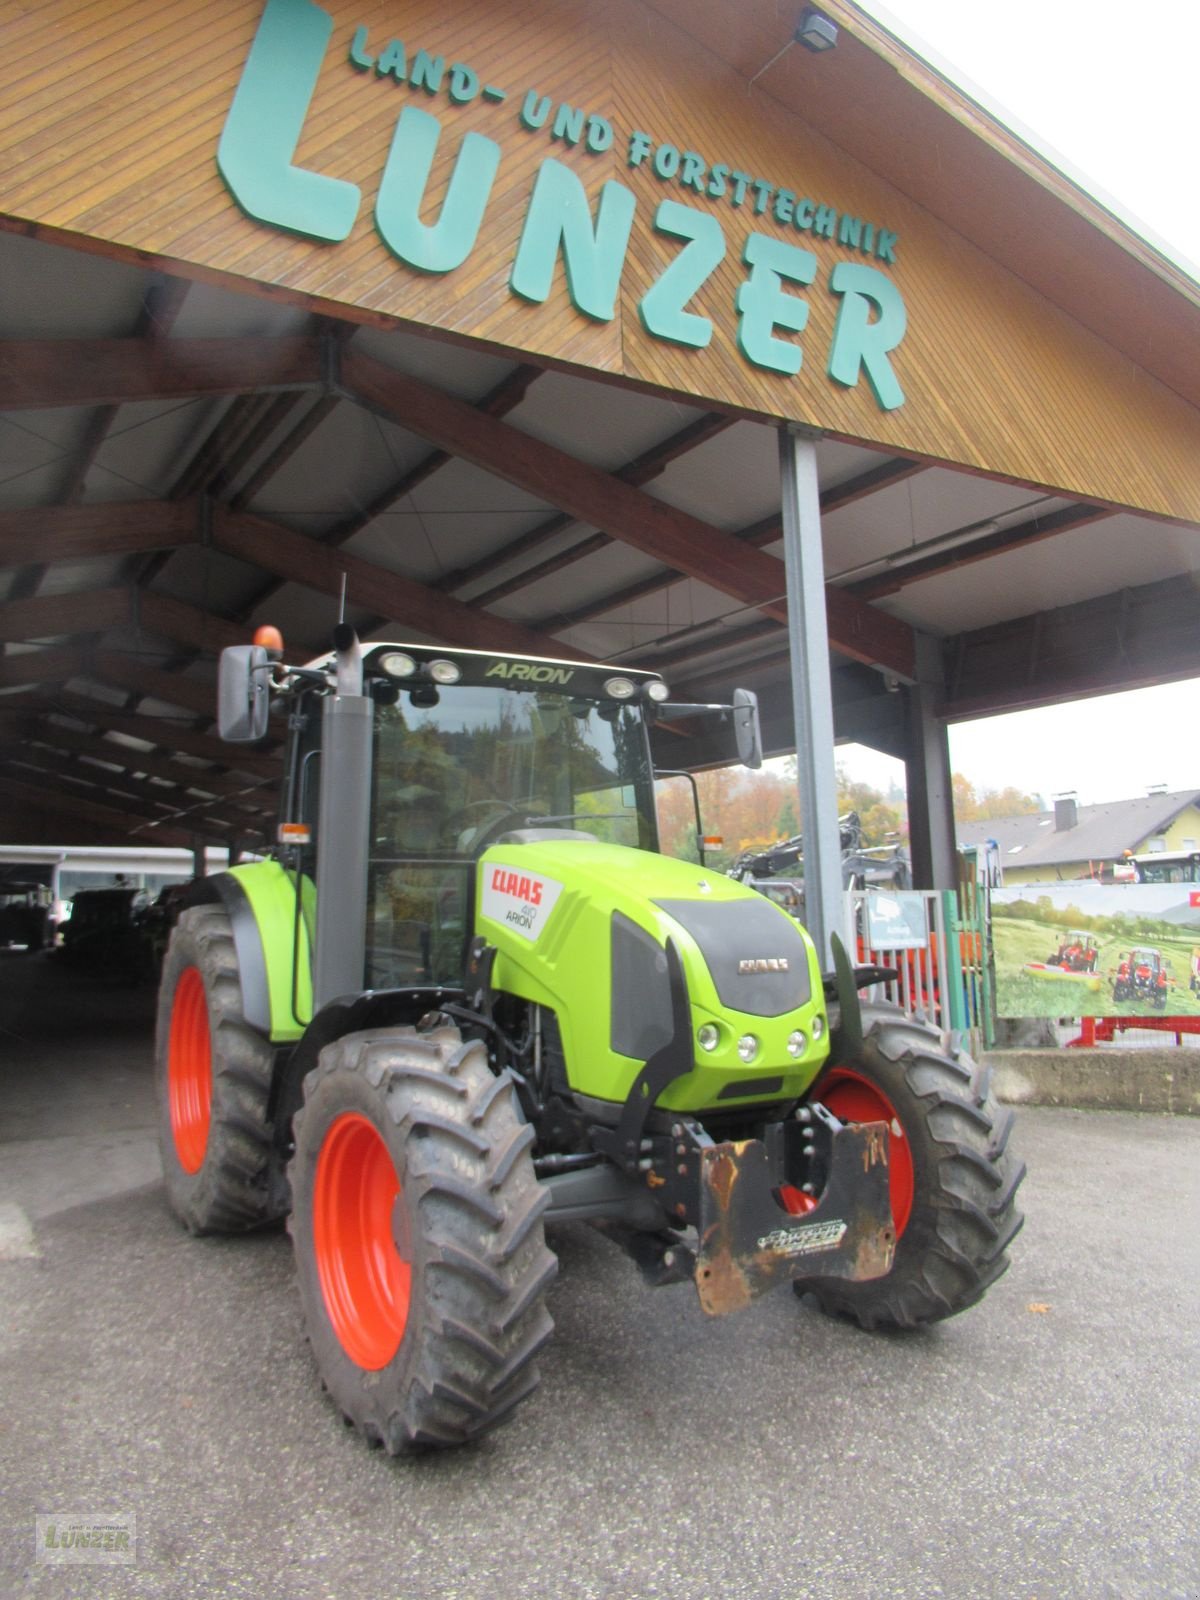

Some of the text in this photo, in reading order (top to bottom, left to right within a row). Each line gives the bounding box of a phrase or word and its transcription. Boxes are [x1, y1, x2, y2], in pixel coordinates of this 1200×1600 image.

[348, 24, 898, 265] LAND- UND FORSTTECHNIK
[216, 0, 907, 412] LUNZER
[485, 662, 575, 685] ARION
[491, 868, 544, 906] CLAAS
[505, 910, 533, 930] ARION
